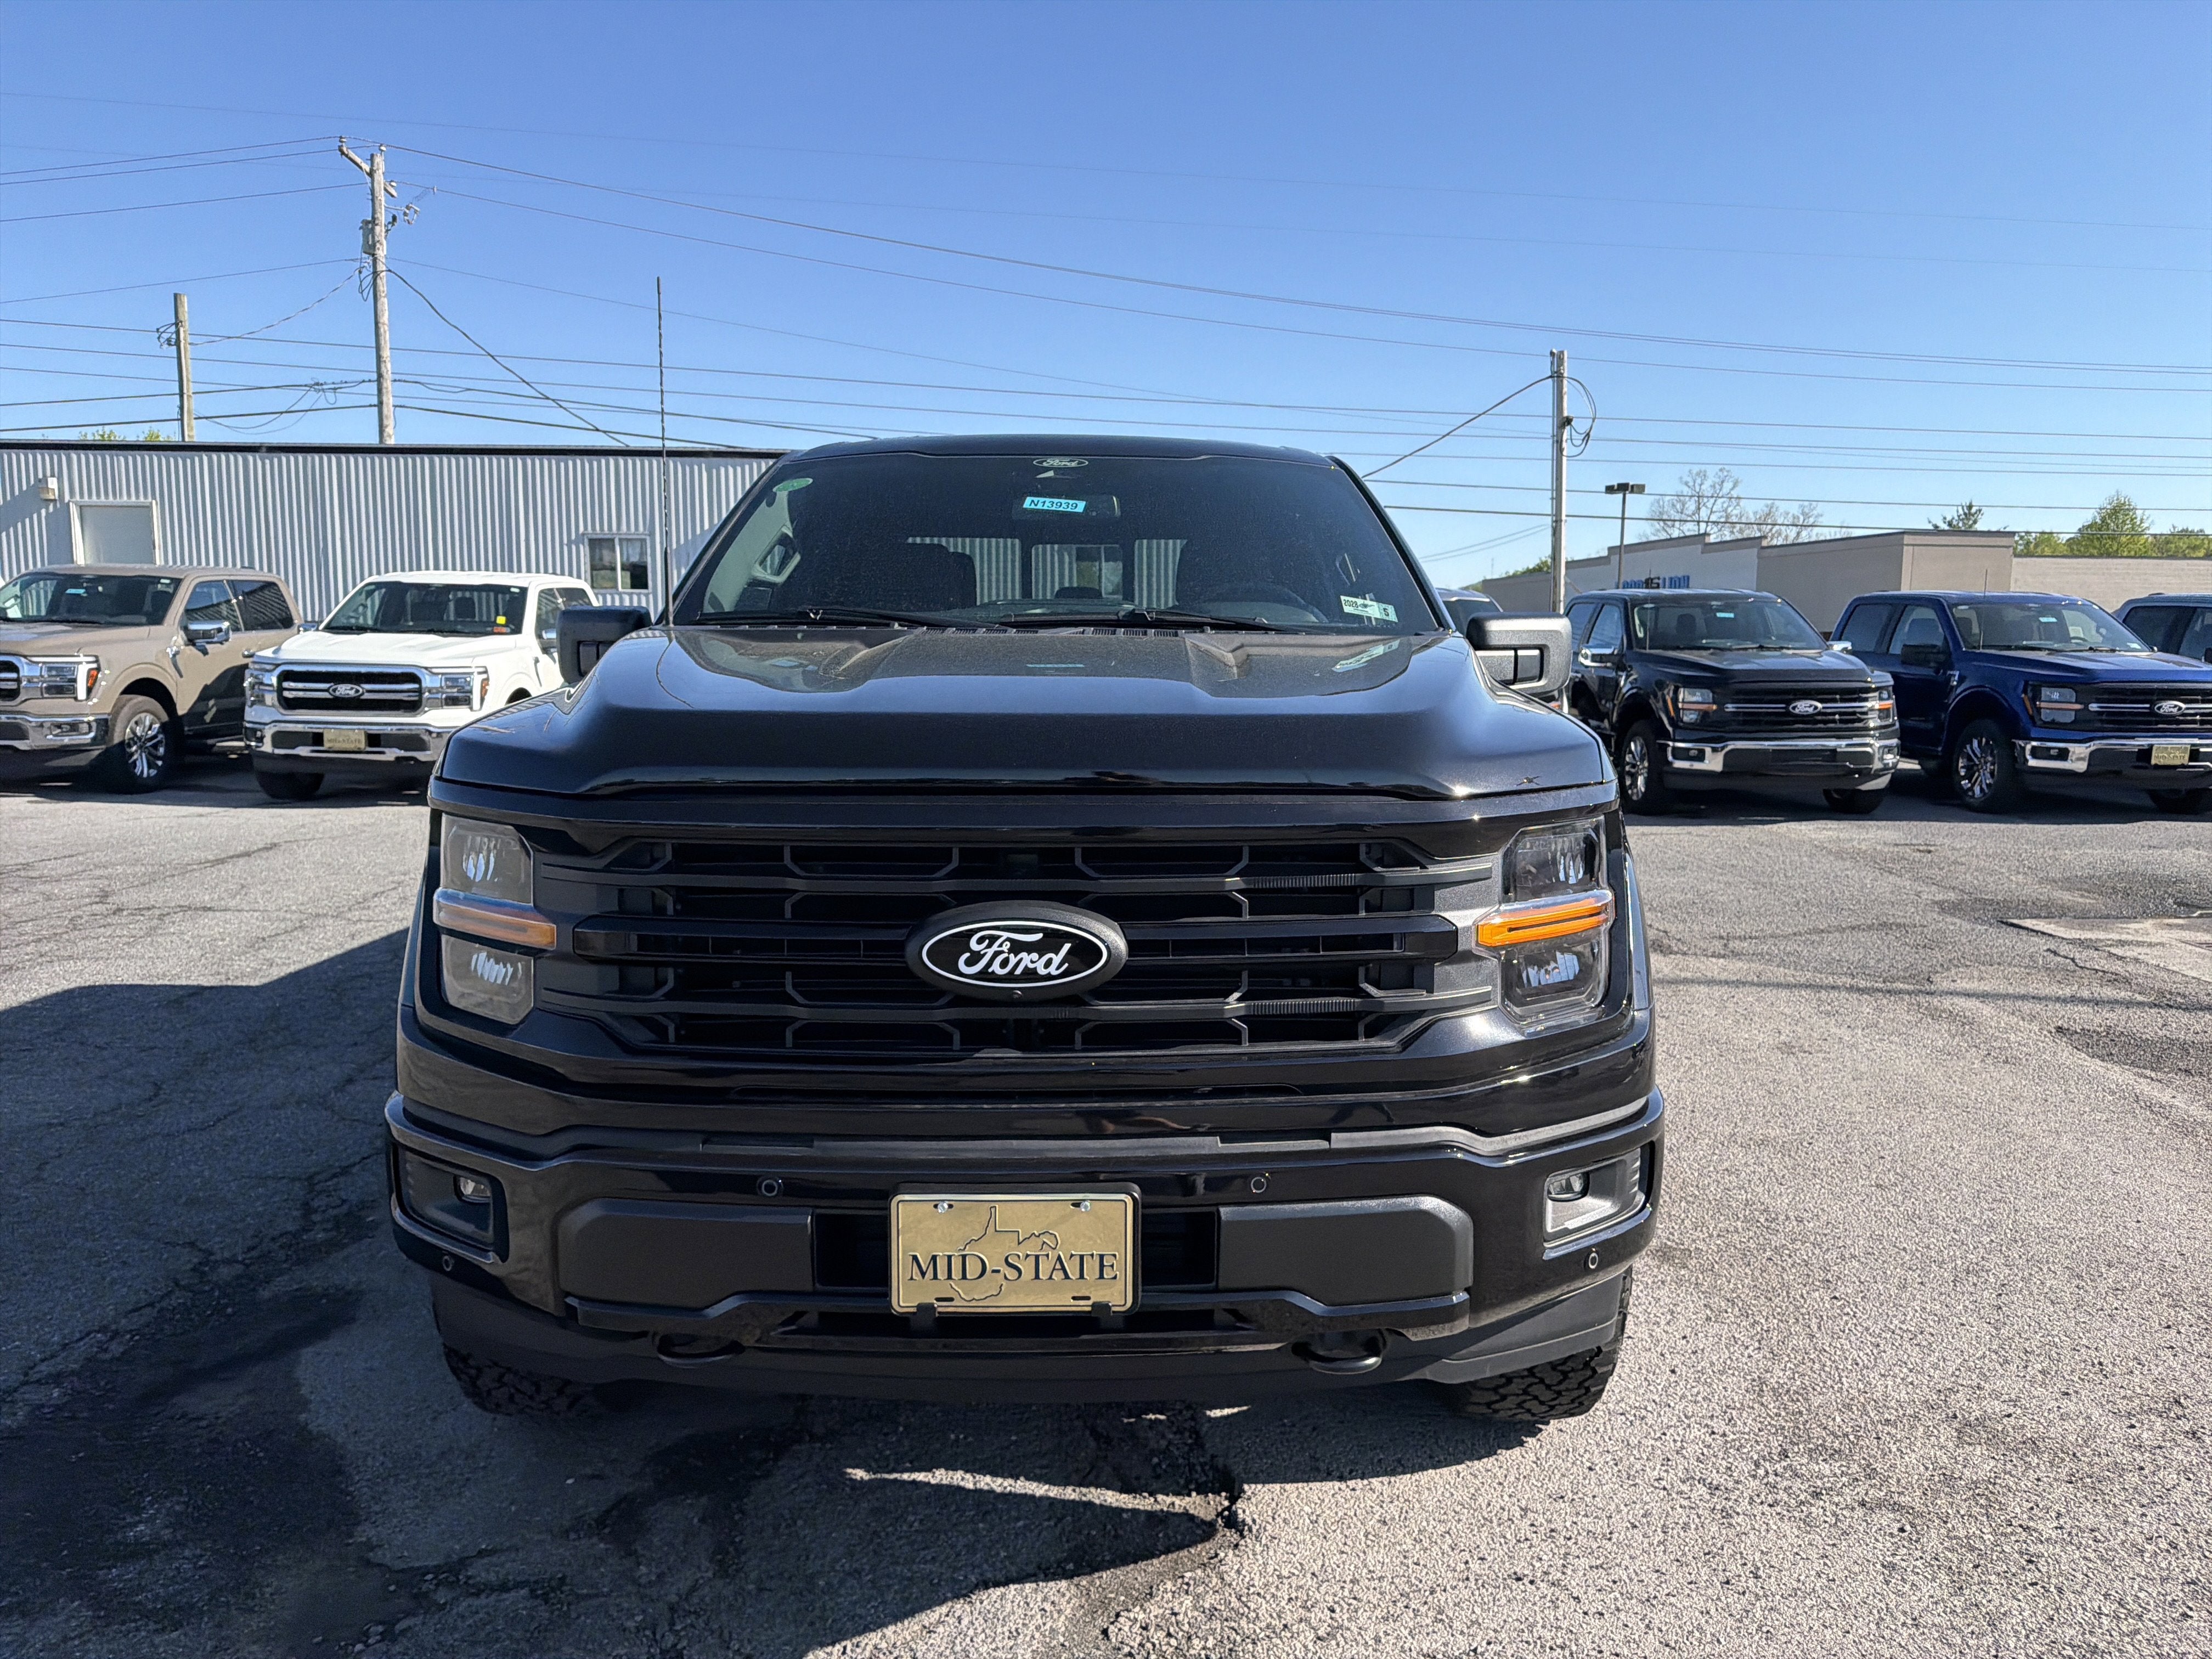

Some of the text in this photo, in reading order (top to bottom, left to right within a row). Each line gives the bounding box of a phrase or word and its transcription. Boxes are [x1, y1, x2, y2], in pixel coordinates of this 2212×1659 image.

[1029, 499, 1078, 510] N13939
[1344, 599, 1359, 608] 2028
[1383, 607, 1390, 617] 5
[336, 686, 356, 695] Ford
[1795, 703, 1815, 713] Ford
[2160, 704, 2179, 713] Ford
[958, 930, 1071, 975] Ford
[907, 1251, 1119, 1281] MID-STATE
